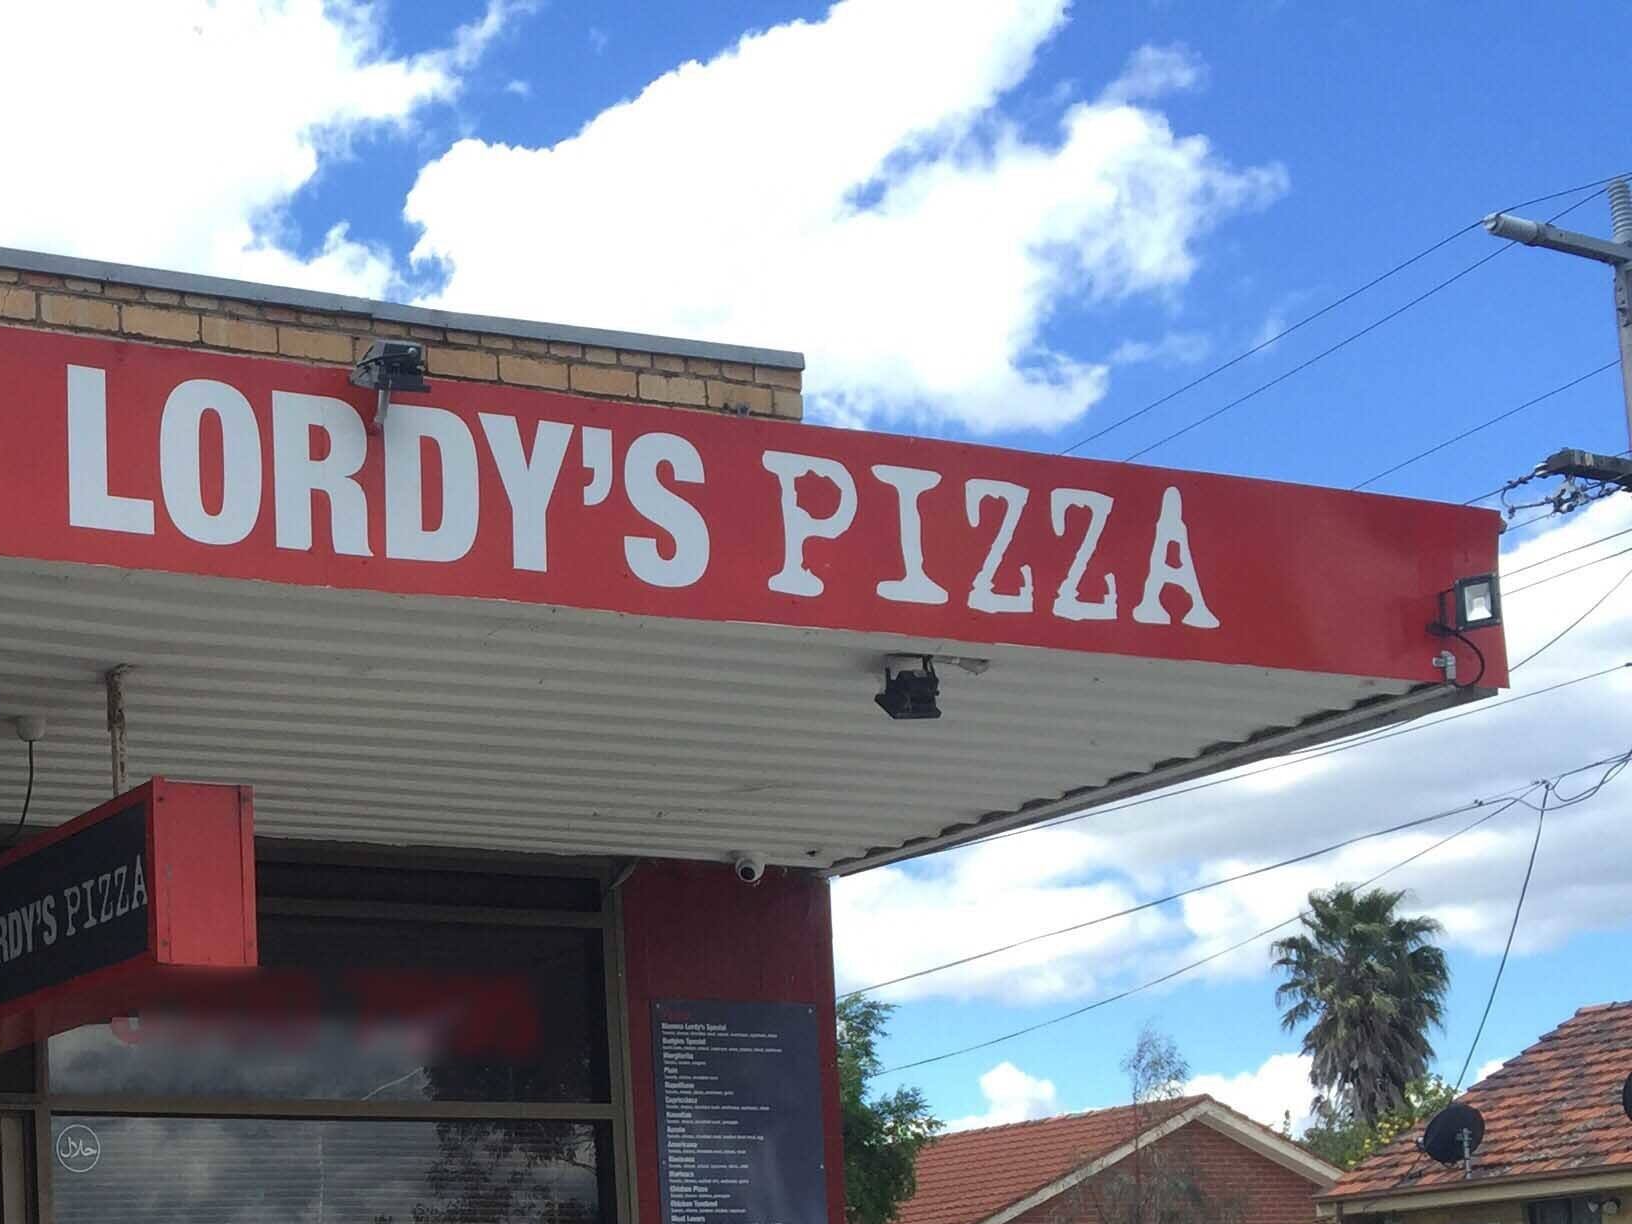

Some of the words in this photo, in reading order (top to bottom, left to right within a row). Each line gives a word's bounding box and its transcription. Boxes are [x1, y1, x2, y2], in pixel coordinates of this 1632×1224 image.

[66, 363, 711, 588] LORDY'S
[762, 449, 1220, 630] PIZZA
[64, 853, 148, 936] PIZZA
